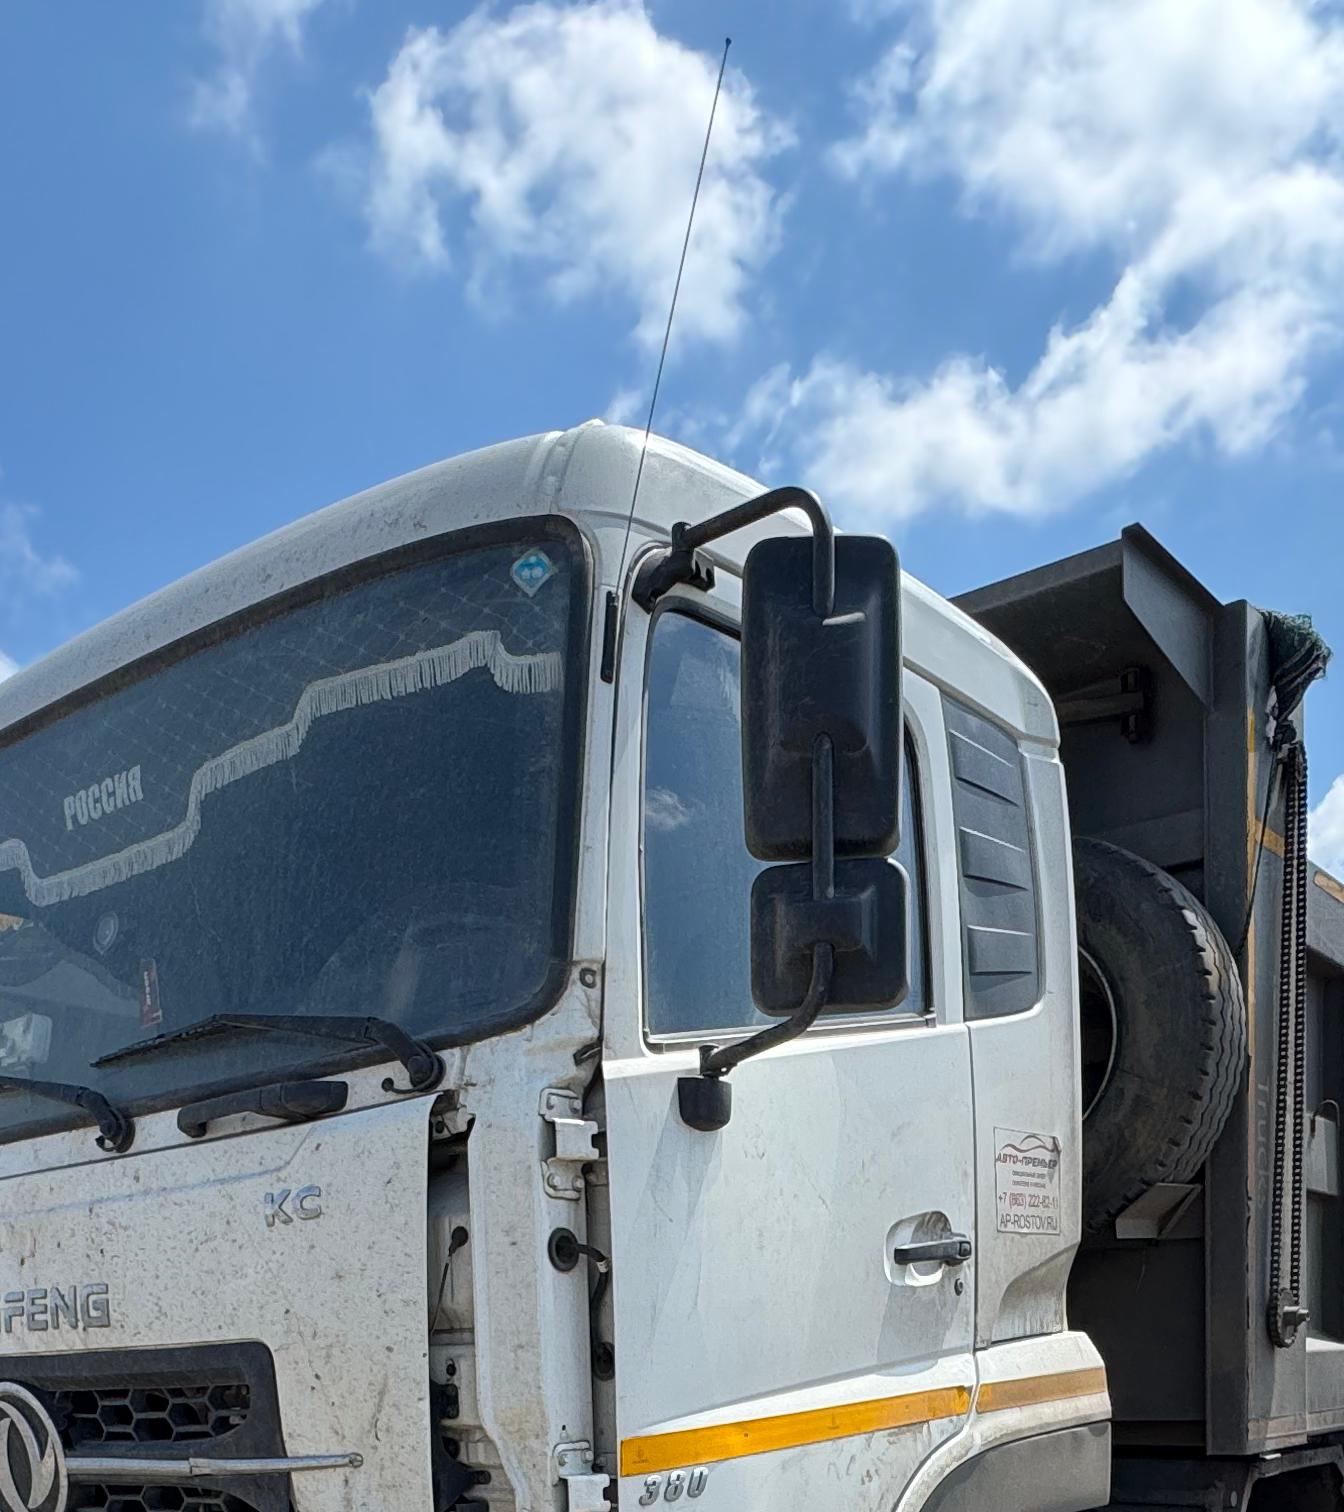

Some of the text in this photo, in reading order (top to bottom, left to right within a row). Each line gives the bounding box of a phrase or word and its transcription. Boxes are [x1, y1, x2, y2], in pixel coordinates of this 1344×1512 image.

[63, 764, 144, 831] РОССИЯ
[264, 1184, 322, 1228] KC
[639, 1466, 709, 1507] 380
